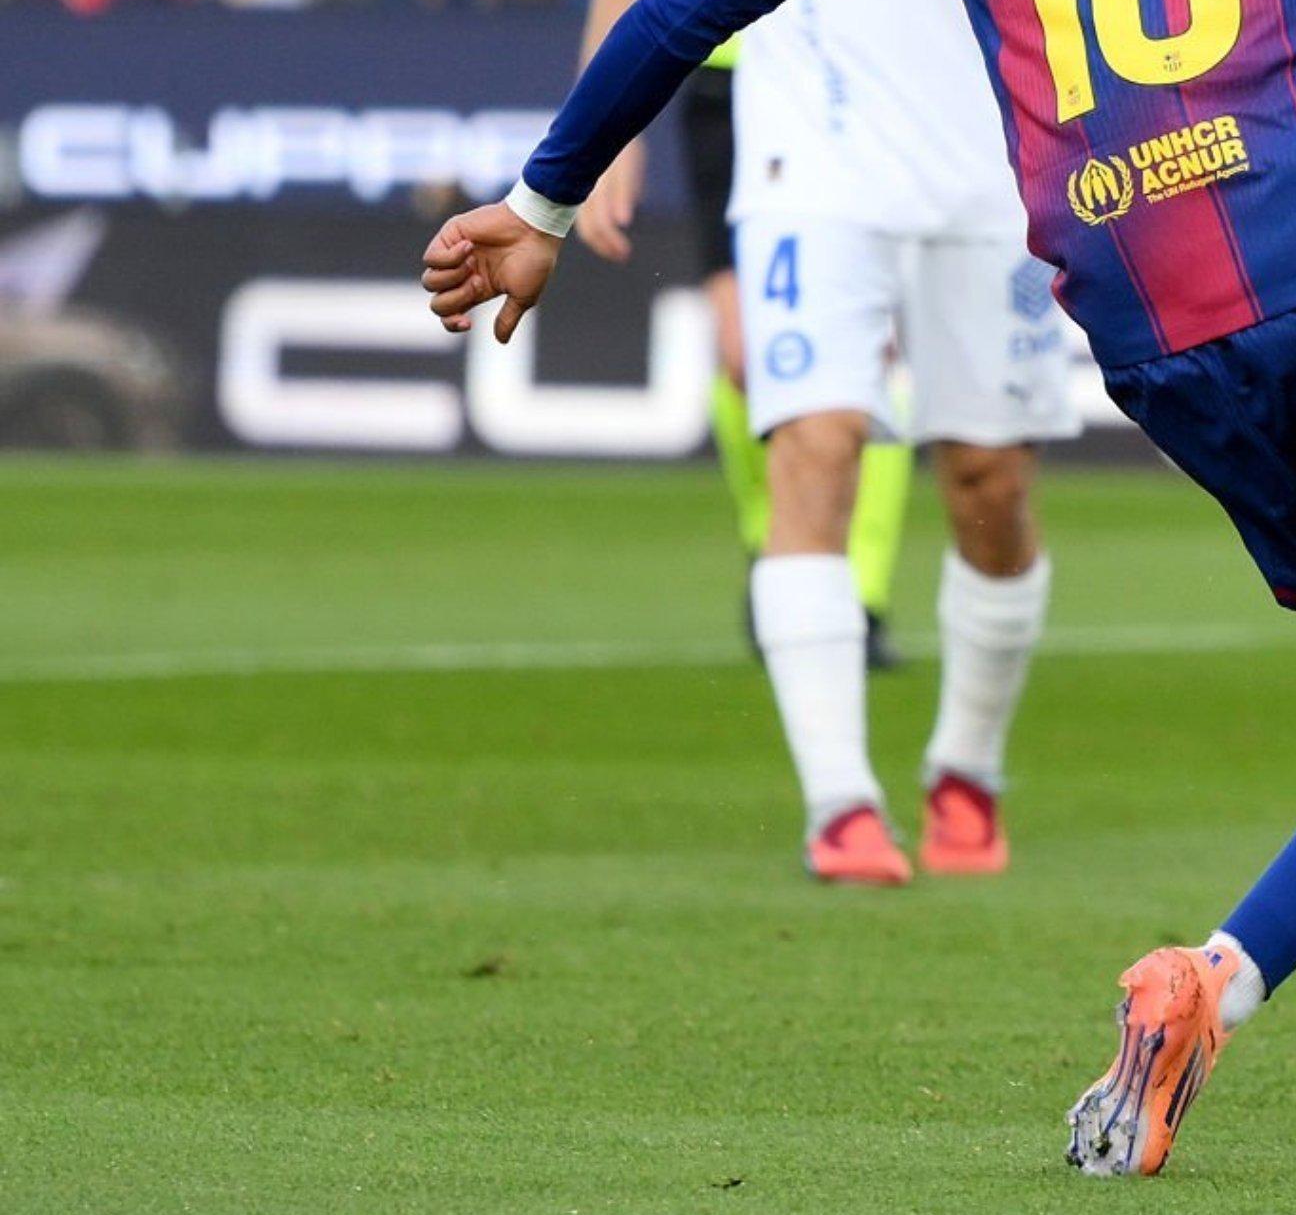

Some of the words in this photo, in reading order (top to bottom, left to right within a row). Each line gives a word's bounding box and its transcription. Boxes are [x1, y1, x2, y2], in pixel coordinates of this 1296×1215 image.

[1129, 114, 1241, 169] UNHCR
[1142, 137, 1248, 196] ACNUR
[763, 237, 800, 309] 4
